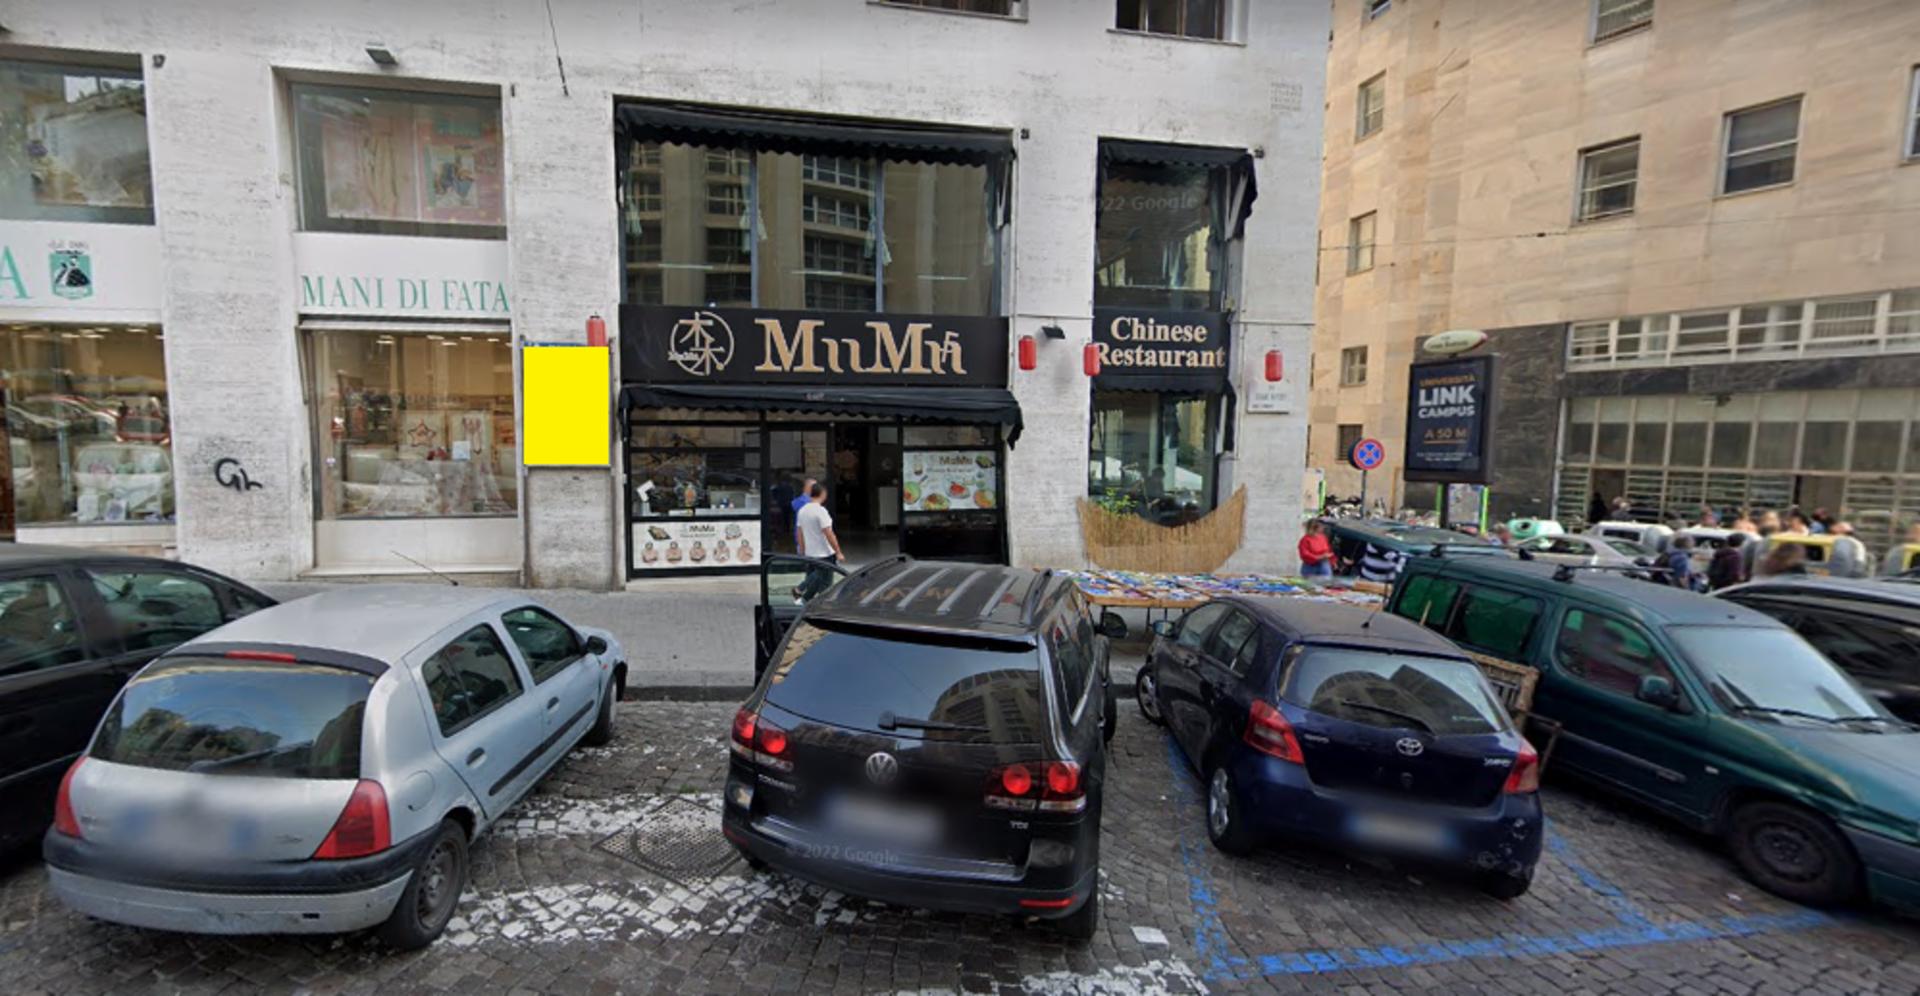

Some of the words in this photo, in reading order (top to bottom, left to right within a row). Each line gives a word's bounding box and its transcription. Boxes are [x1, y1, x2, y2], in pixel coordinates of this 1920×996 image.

[0, 245, 34, 299] A
[301, 275, 384, 308] MANI
[398, 278, 430, 310] DI
[442, 280, 510, 313] FATA
[1110, 316, 1208, 343] Chinese
[1097, 341, 1226, 368] Restaurant
[1419, 384, 1476, 407] LINK
[1418, 405, 1476, 419] CAMPUS
[1424, 429, 1435, 439] A
[1437, 427, 1453, 439] 50
[1455, 427, 1468, 438] M
